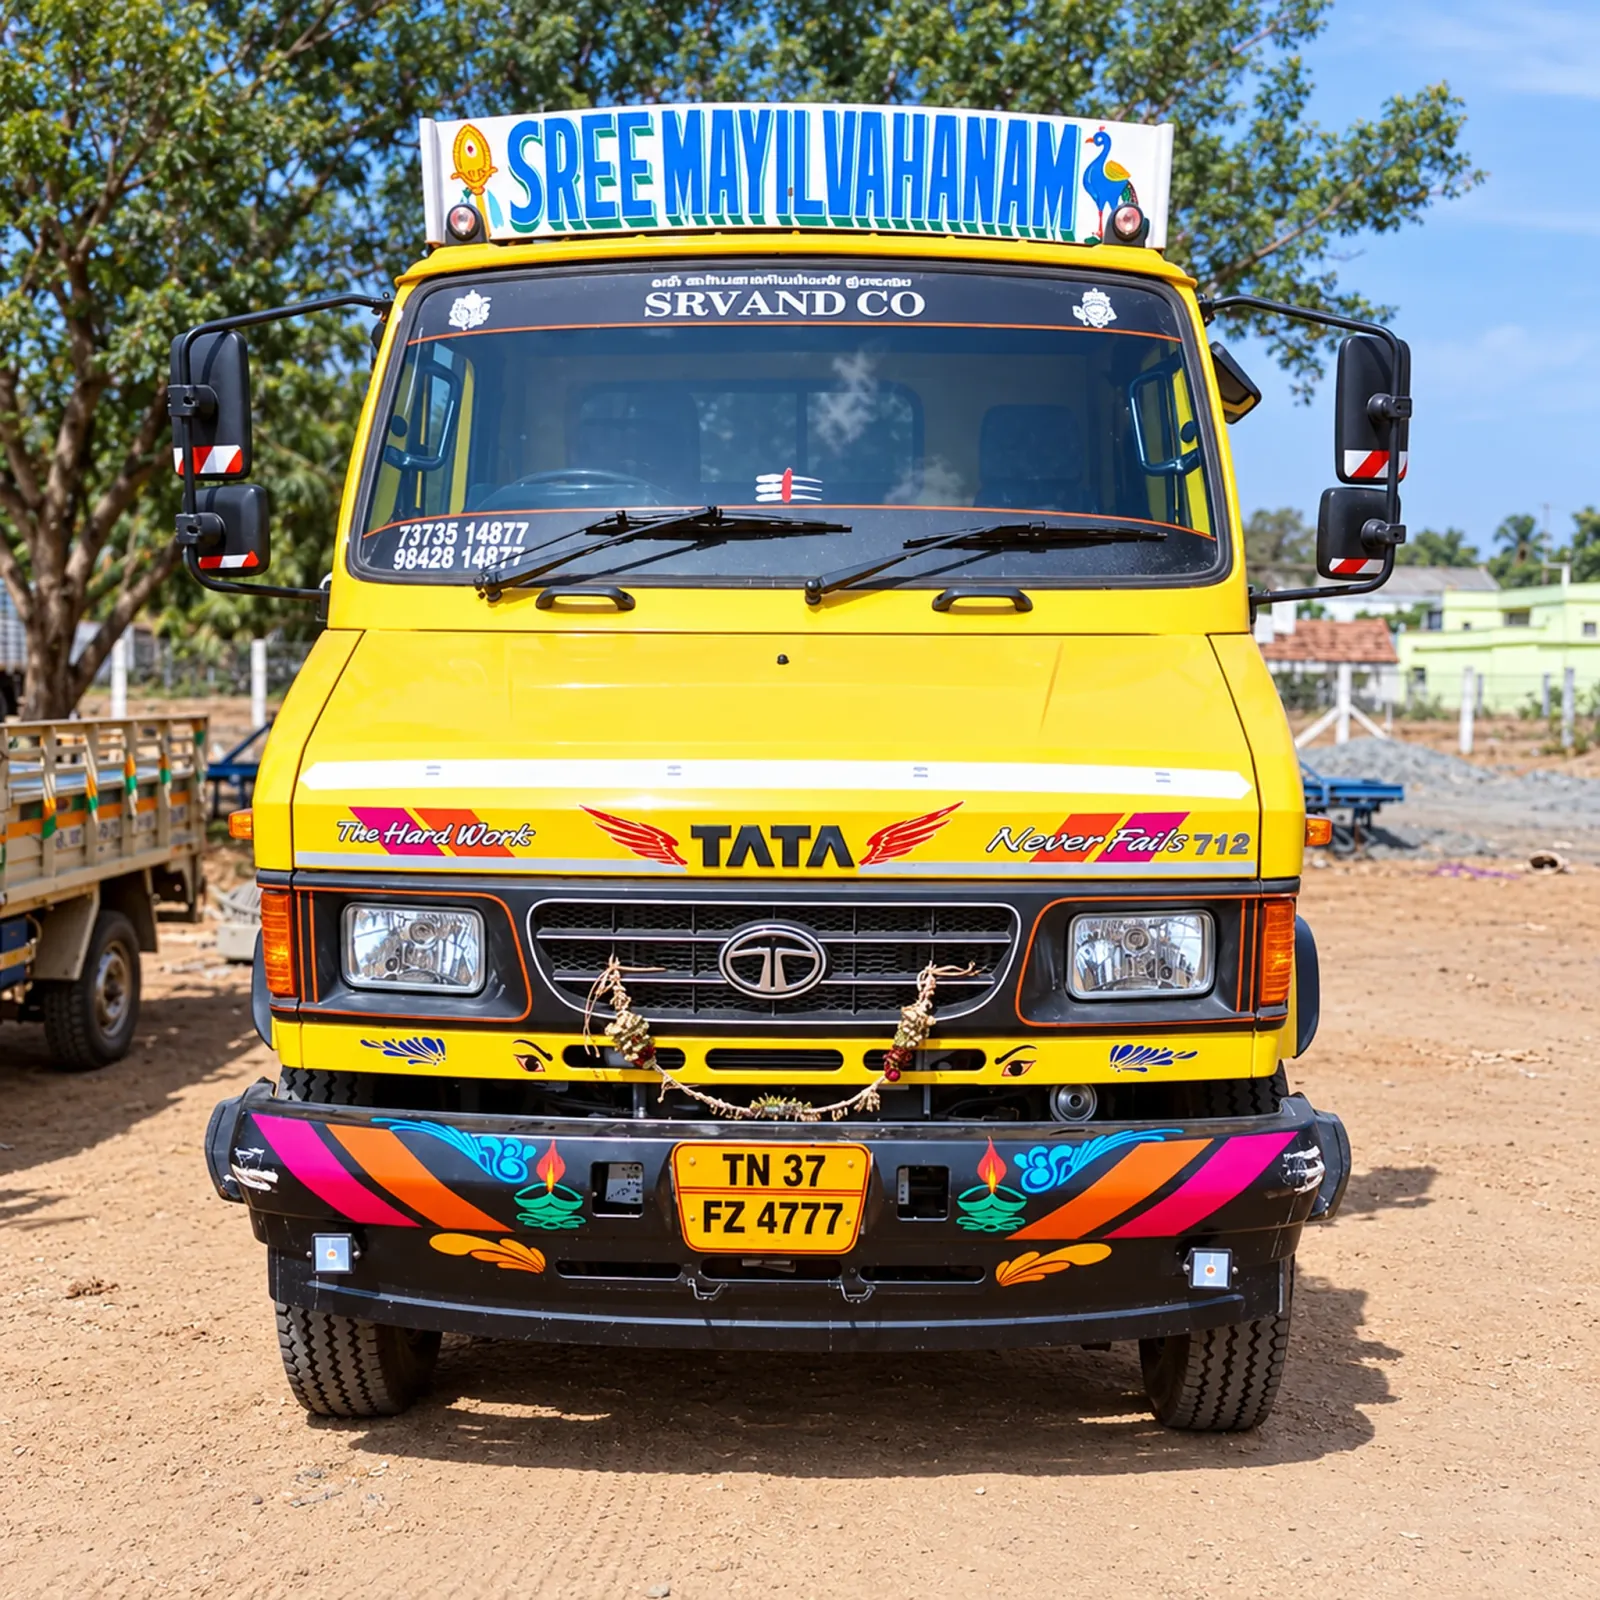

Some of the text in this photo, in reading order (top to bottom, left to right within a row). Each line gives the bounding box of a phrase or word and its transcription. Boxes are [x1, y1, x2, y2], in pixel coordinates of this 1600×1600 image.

[507, 107, 1082, 241] SREE MAYILVAHANAM
[644, 290, 926, 318] SRVAND CO
[398, 521, 529, 547] 73735 14877
[393, 546, 455, 570] 98428
[337, 821, 536, 847] The Hard Work
[690, 824, 855, 869] TATA
[986, 826, 1190, 854] Never Fails
[1194, 833, 1251, 855] 712
[722, 1153, 826, 1187] TN 37
[703, 1200, 844, 1235] FZ 4777
